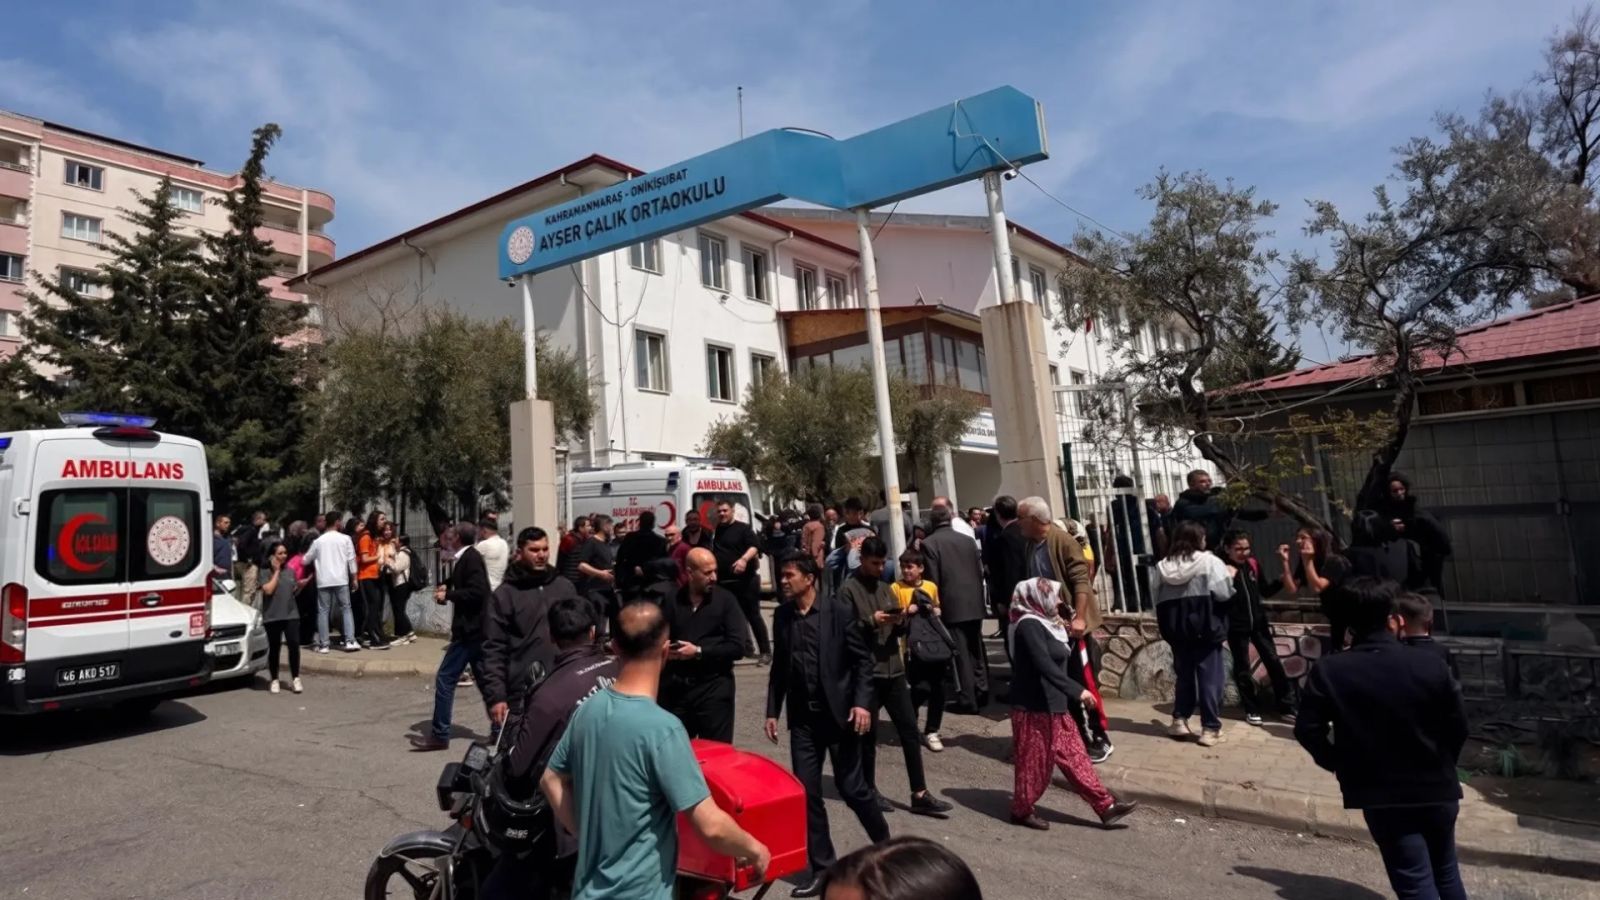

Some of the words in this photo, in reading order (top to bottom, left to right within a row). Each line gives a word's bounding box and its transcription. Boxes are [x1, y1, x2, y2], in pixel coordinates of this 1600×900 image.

[545, 189, 623, 225] KAHRAMANMARAŞ
[631, 168, 688, 198] ONİKİŞUBAT
[540, 225, 581, 252] AYŞER
[586, 212, 628, 242] ÇALIK
[631, 176, 725, 222] ORTAOKULU
[61, 460, 184, 480] AMBULANS
[697, 480, 743, 491] AMBULANS
[63, 670, 76, 681] 46
[99, 665, 116, 677] 517
